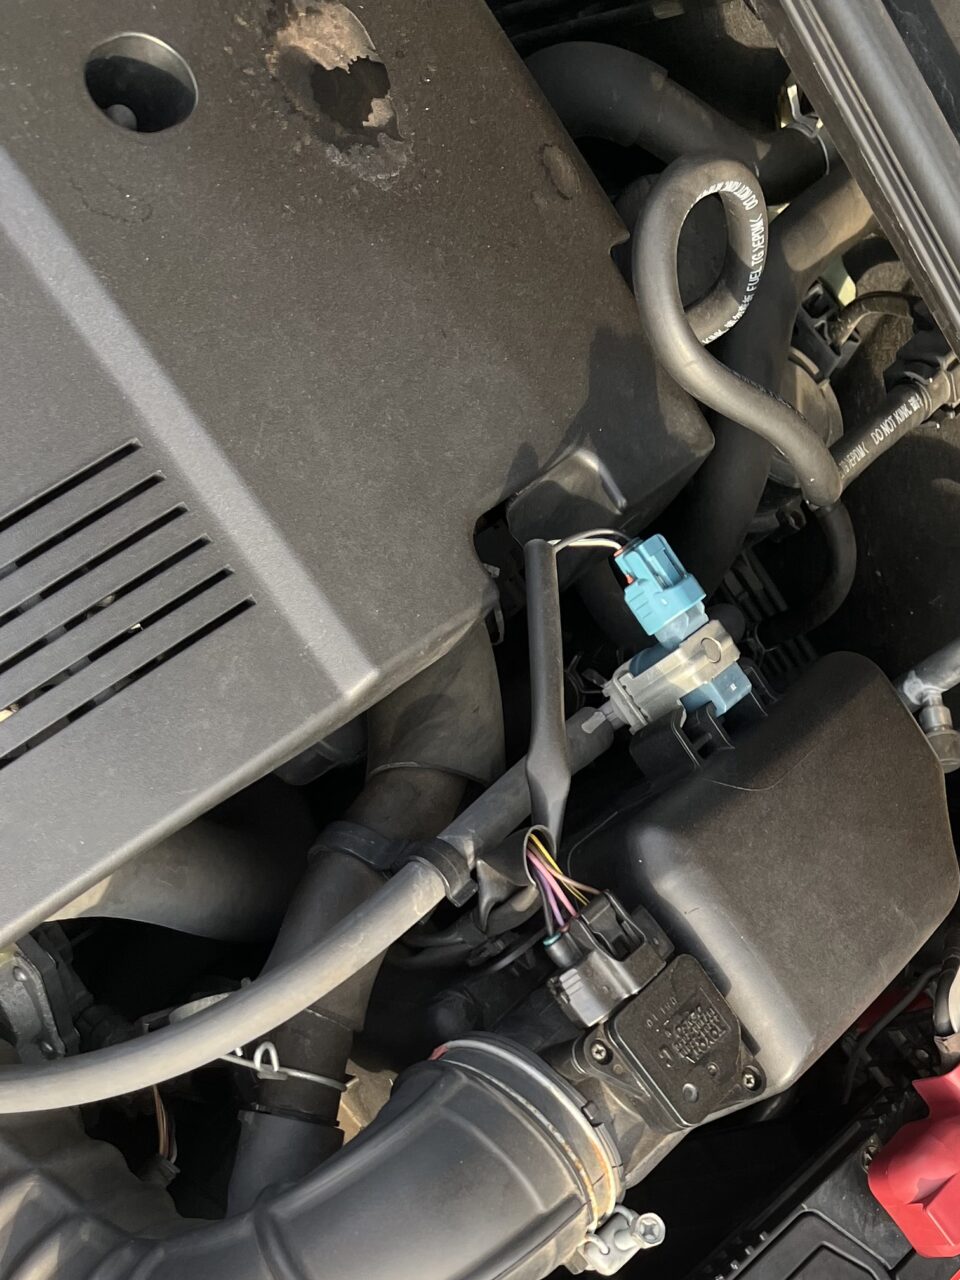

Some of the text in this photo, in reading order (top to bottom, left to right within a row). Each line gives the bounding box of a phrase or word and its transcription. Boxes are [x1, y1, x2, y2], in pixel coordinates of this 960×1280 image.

[744, 267, 762, 294] FUEL
[870, 428, 884, 446] DO
[880, 414, 897, 437] NOT
